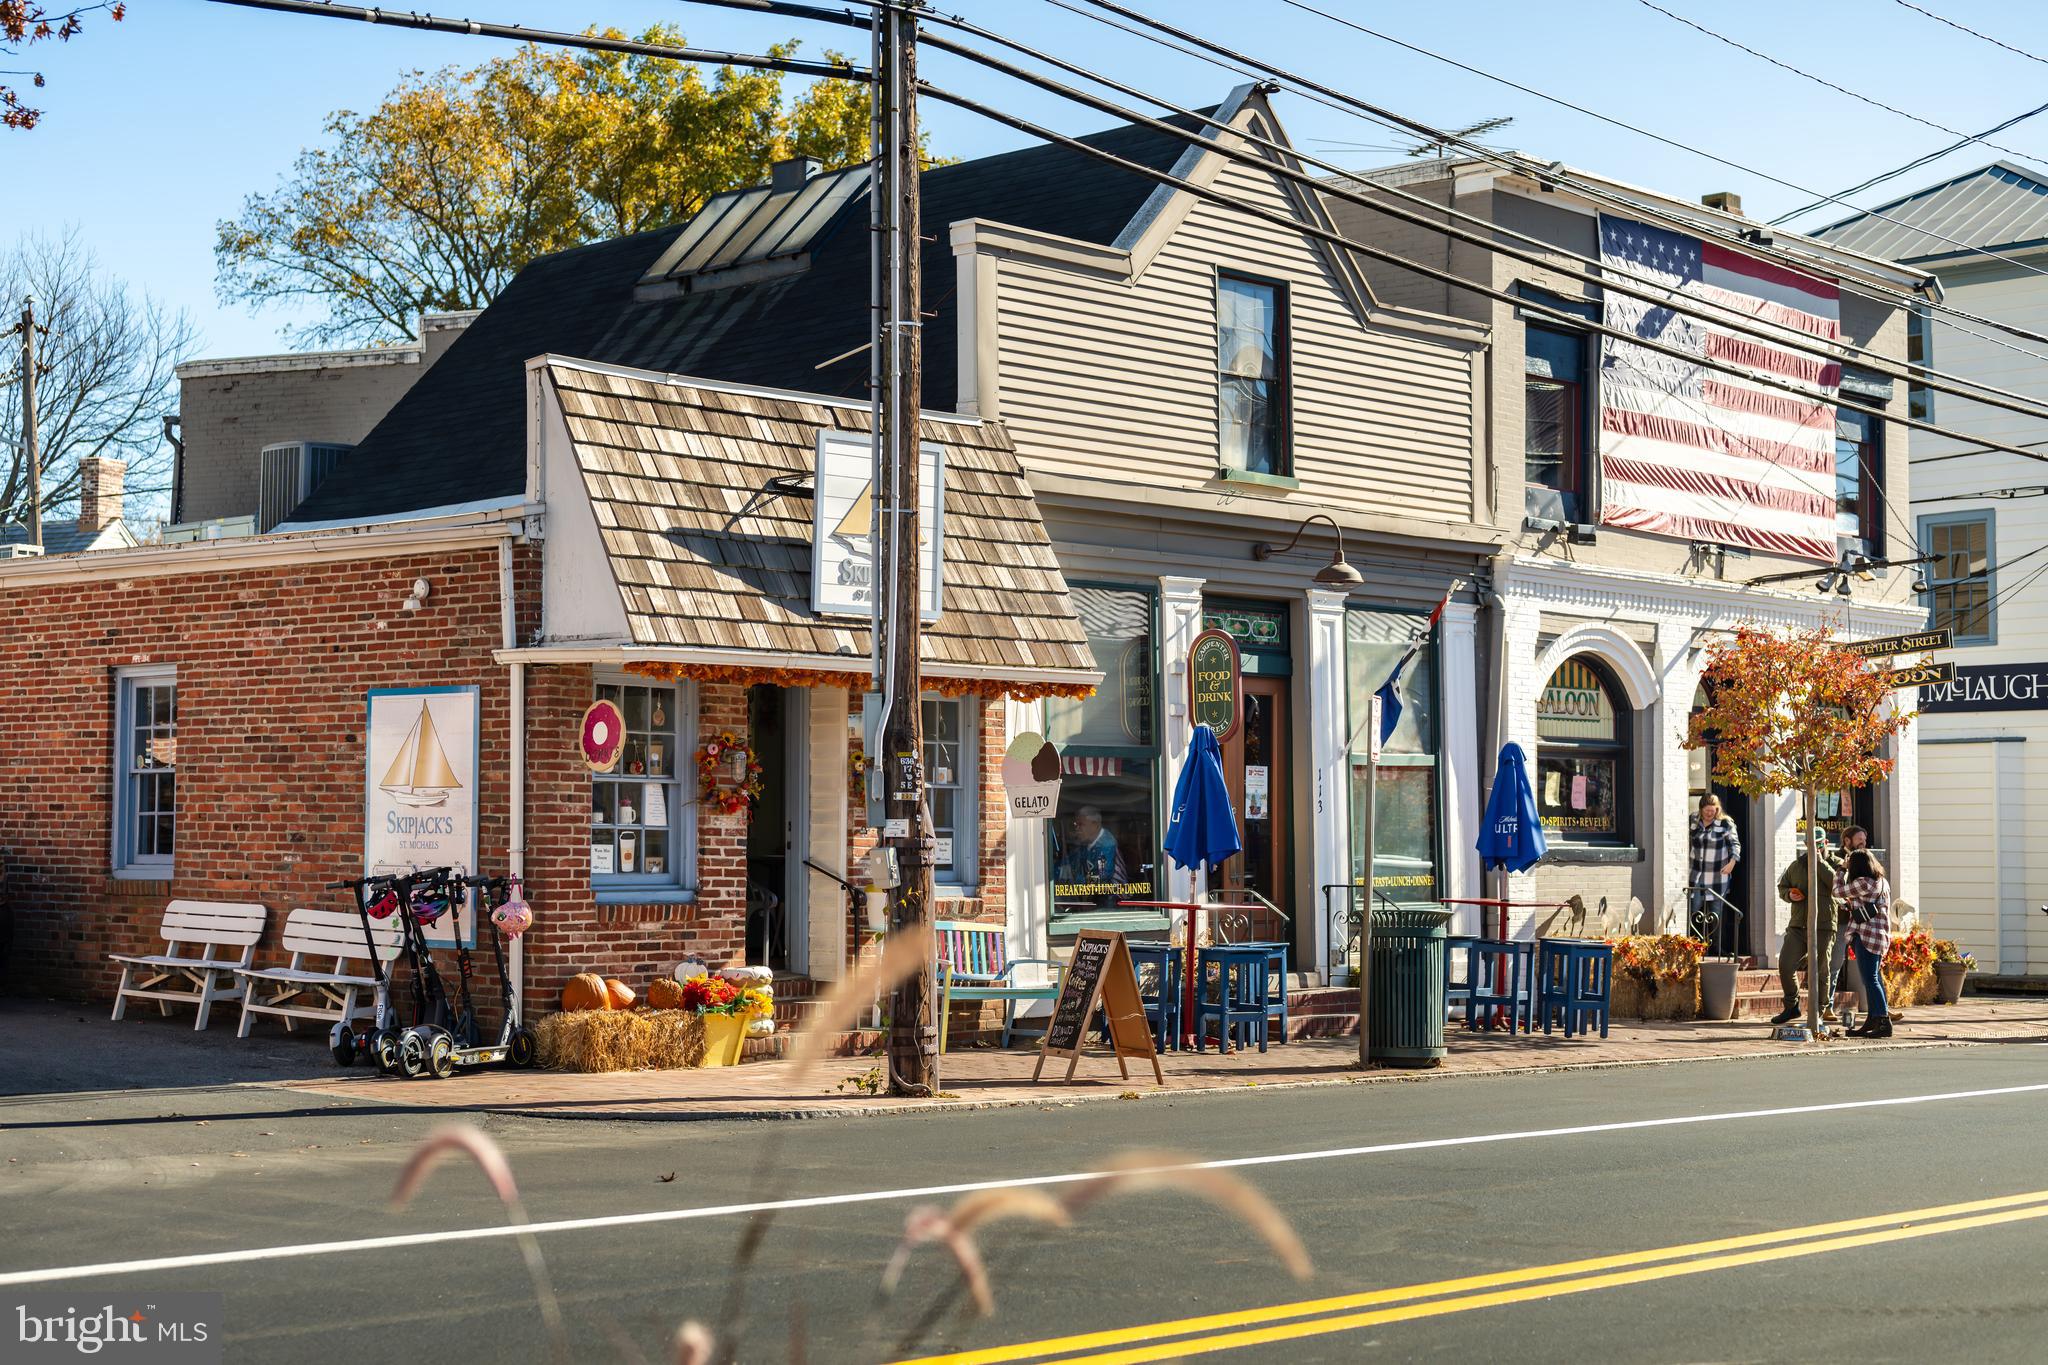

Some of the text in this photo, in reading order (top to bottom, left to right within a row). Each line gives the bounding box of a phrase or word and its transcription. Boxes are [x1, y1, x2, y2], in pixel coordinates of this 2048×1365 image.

[1900, 634, 1942, 651] STREET
[1197, 640, 1230, 661] CARPENTER
[1198, 670, 1231, 681] FOOD
[1209, 681, 1220, 692] &
[1198, 691, 1232, 703] DRINK
[1537, 690, 1600, 716] SALOON
[1014, 795, 1049, 809] GELATO
[387, 810, 453, 839] SKIPJACK'S
[1548, 816, 1577, 827] SPIRITS
[409, 840, 439, 849] MICHAELS
[1055, 882, 1152, 896] BREAKFAST LUNCH DINNER
